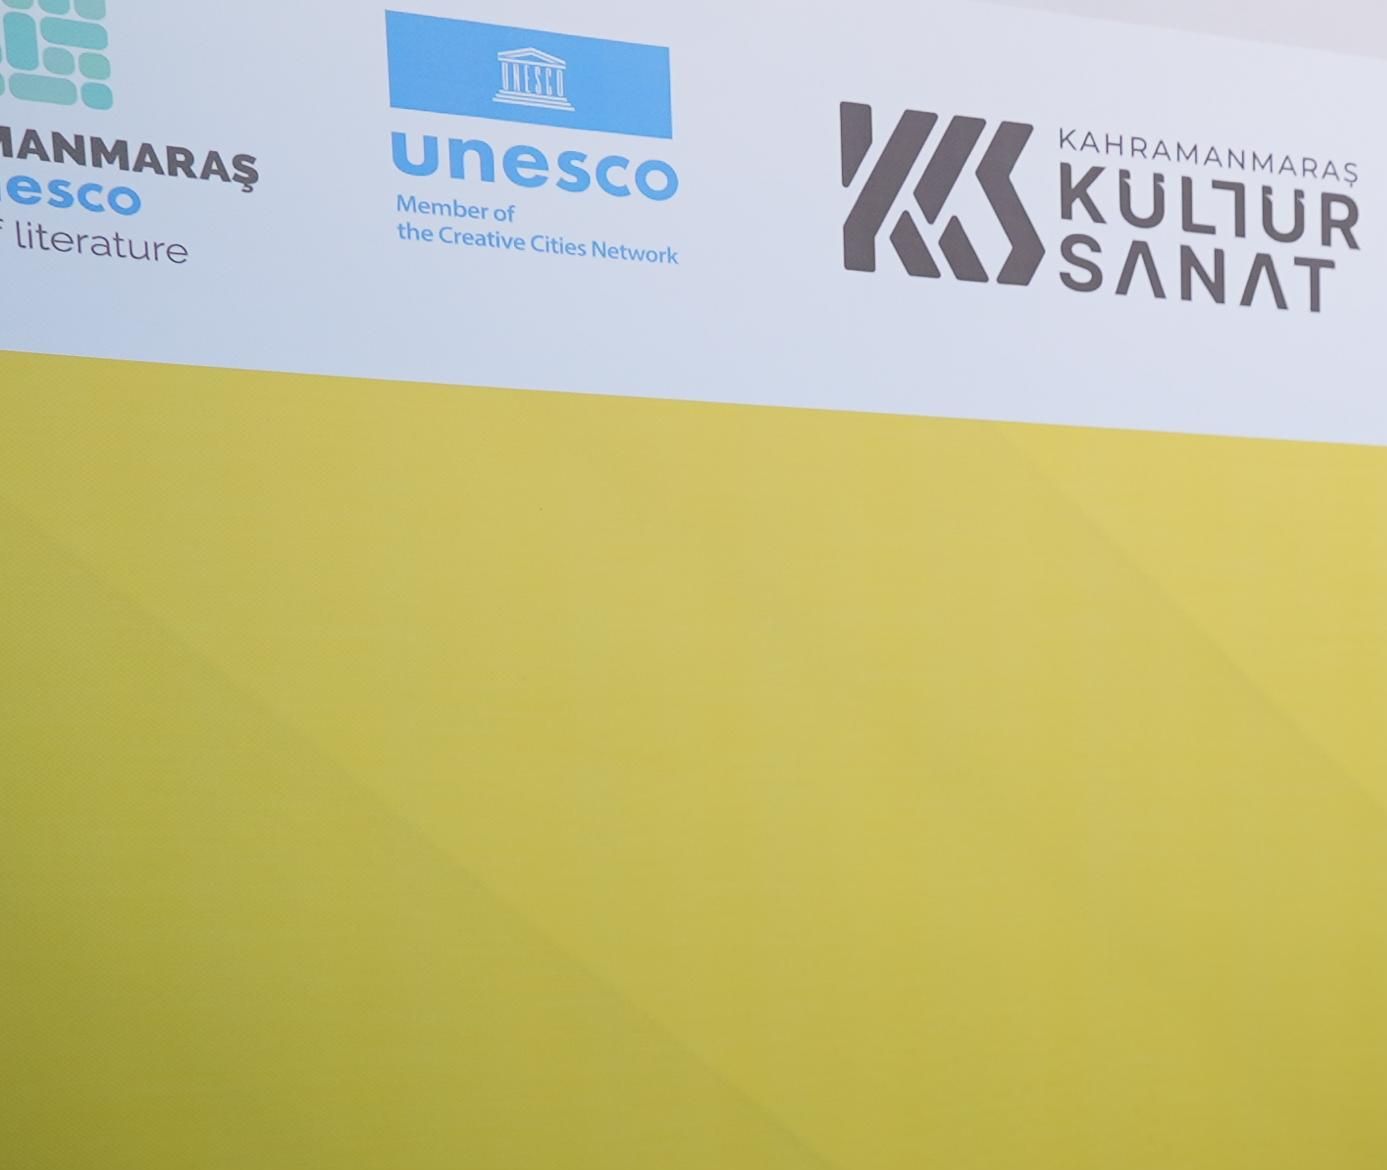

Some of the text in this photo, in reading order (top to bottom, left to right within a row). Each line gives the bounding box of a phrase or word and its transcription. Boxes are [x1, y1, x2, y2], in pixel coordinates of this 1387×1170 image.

[501, 61, 565, 97] UNESCO
[391, 131, 679, 202] unesco
[1059, 127, 1360, 186] KAHRAMANMARAŞ
[0, 175, 142, 216] esco
[397, 194, 516, 223] Member of
[16, 220, 189, 264] literature
[397, 222, 679, 264] the Creative Cities Network
[1058, 233, 1336, 313] SANAT
